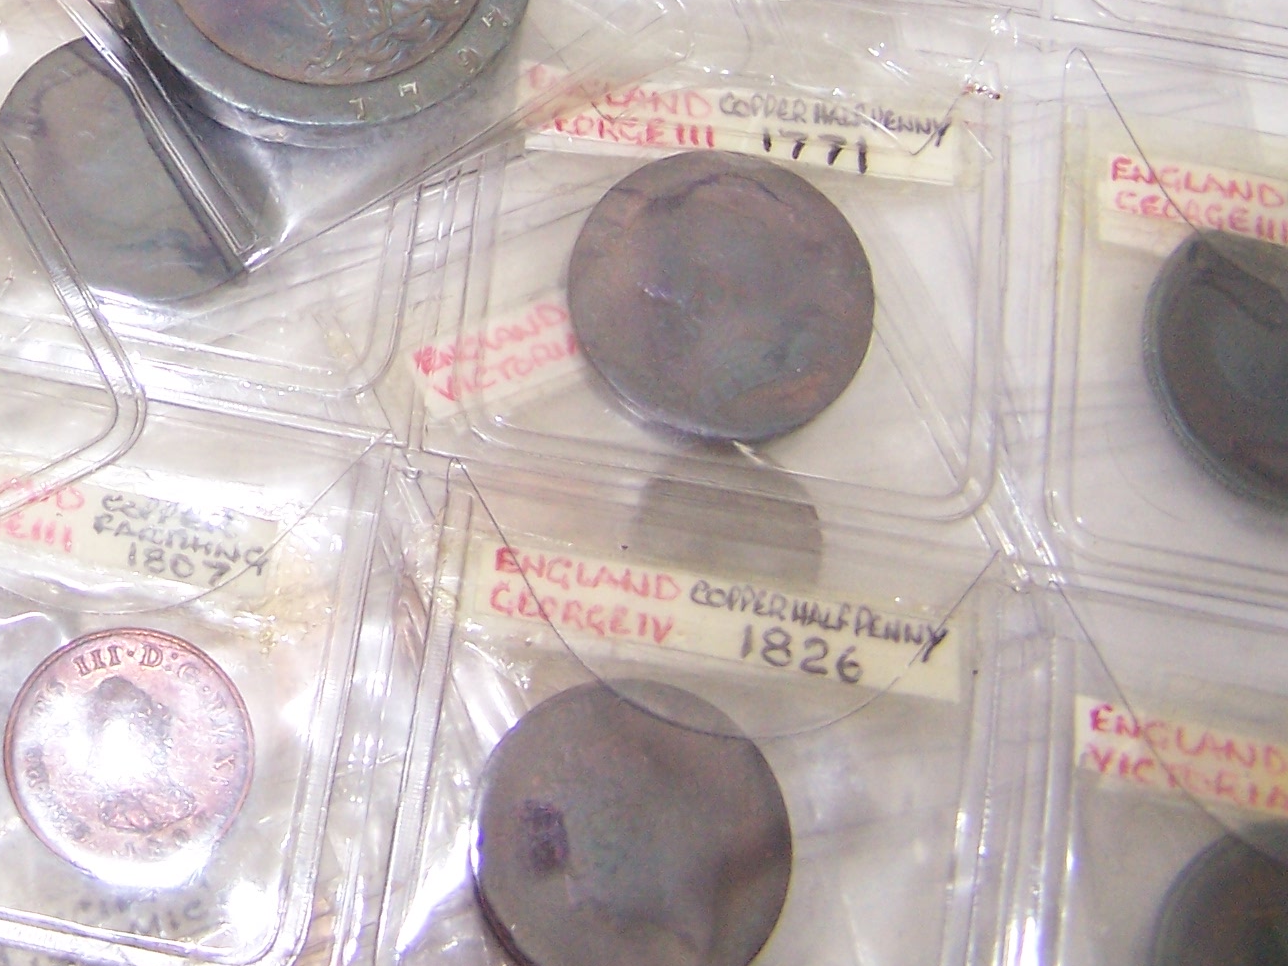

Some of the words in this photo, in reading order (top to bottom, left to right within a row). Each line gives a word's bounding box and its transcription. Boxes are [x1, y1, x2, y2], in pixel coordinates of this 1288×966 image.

[718, 91, 808, 125] COPPER
[675, 122, 716, 149] III
[761, 126, 869, 175] 1771
[1111, 155, 1285, 209] ENGLAND
[1114, 189, 1251, 235] GEORGE
[92, 512, 270, 576] FARTHING
[126, 541, 233, 587] 1807
[495, 544, 681, 602] ENGLAND
[689, 578, 786, 623] COPPER
[489, 580, 630, 638] GEORGE
[637, 611, 675, 645] IV
[740, 622, 864, 685] 1826
